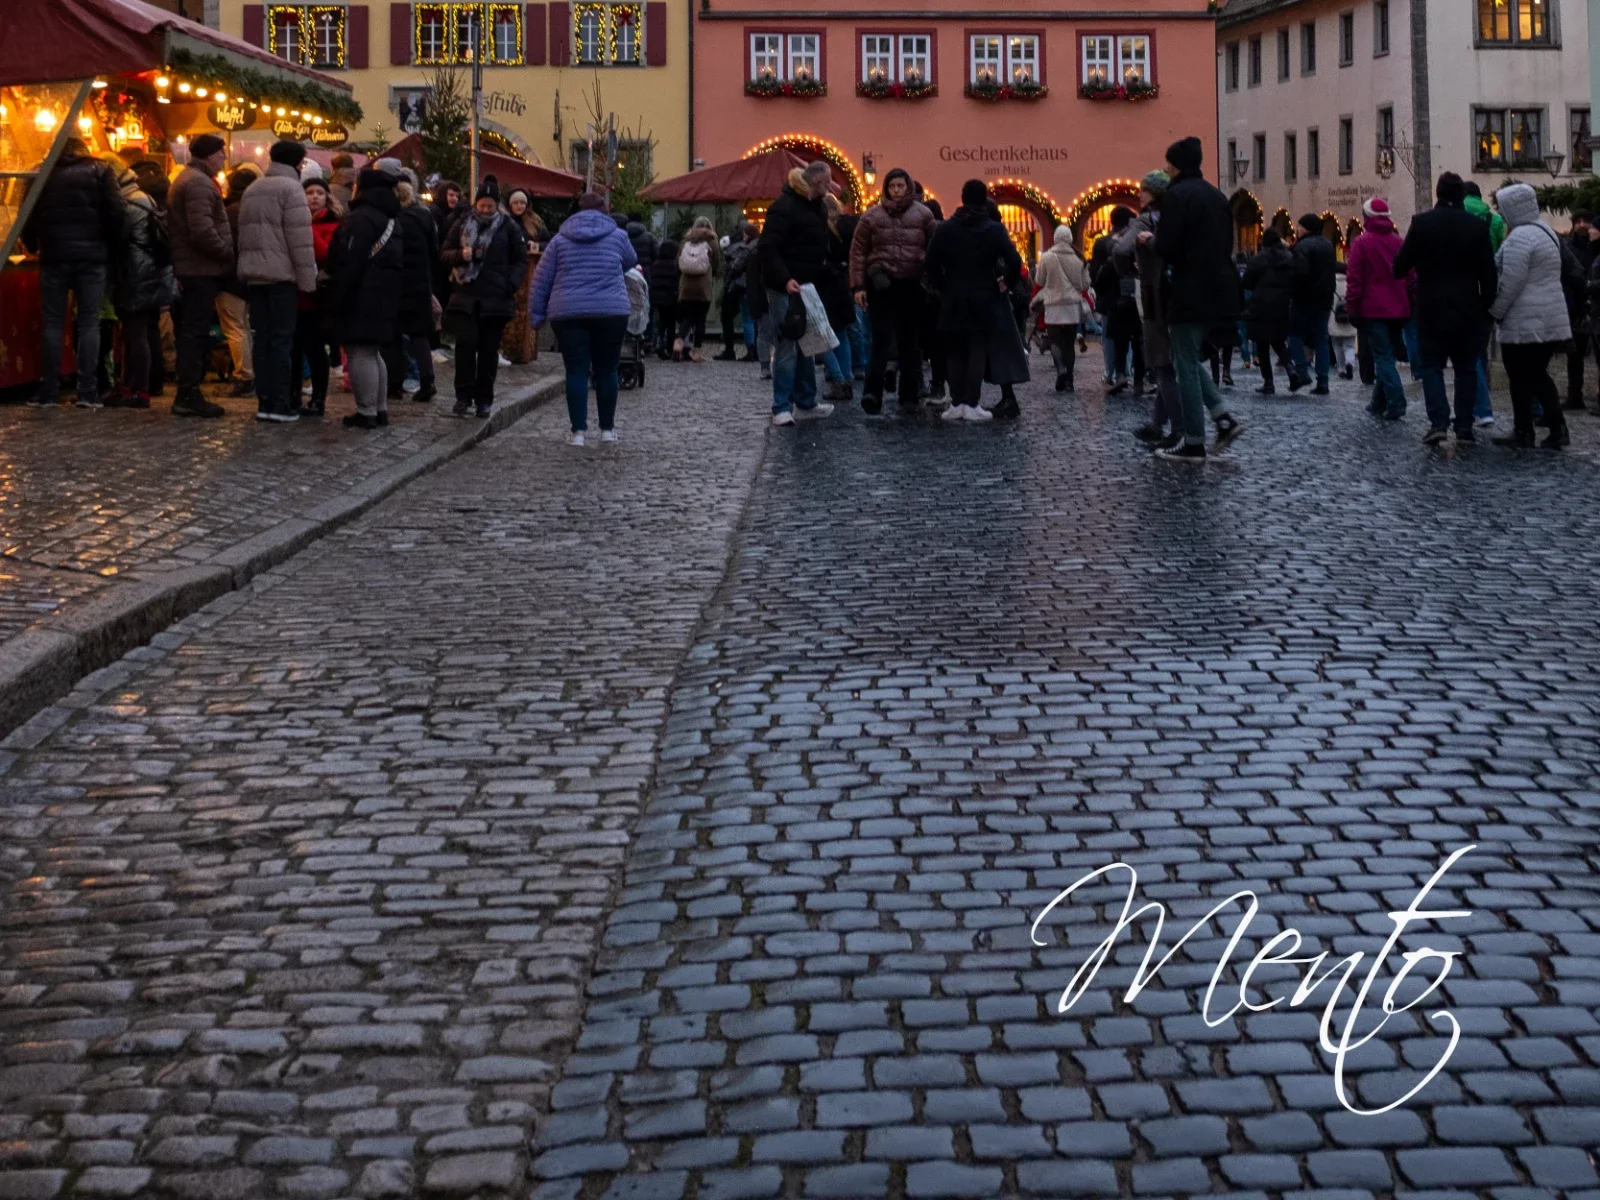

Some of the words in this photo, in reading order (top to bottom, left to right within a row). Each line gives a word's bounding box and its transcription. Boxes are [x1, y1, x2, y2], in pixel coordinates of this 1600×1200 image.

[216, 104, 245, 130] Waffel
[311, 128, 346, 144] Glühwein
[939, 145, 1069, 161] Geschenkehaus
[984, 166, 1000, 176] am
[1003, 165, 1031, 176] Markt
